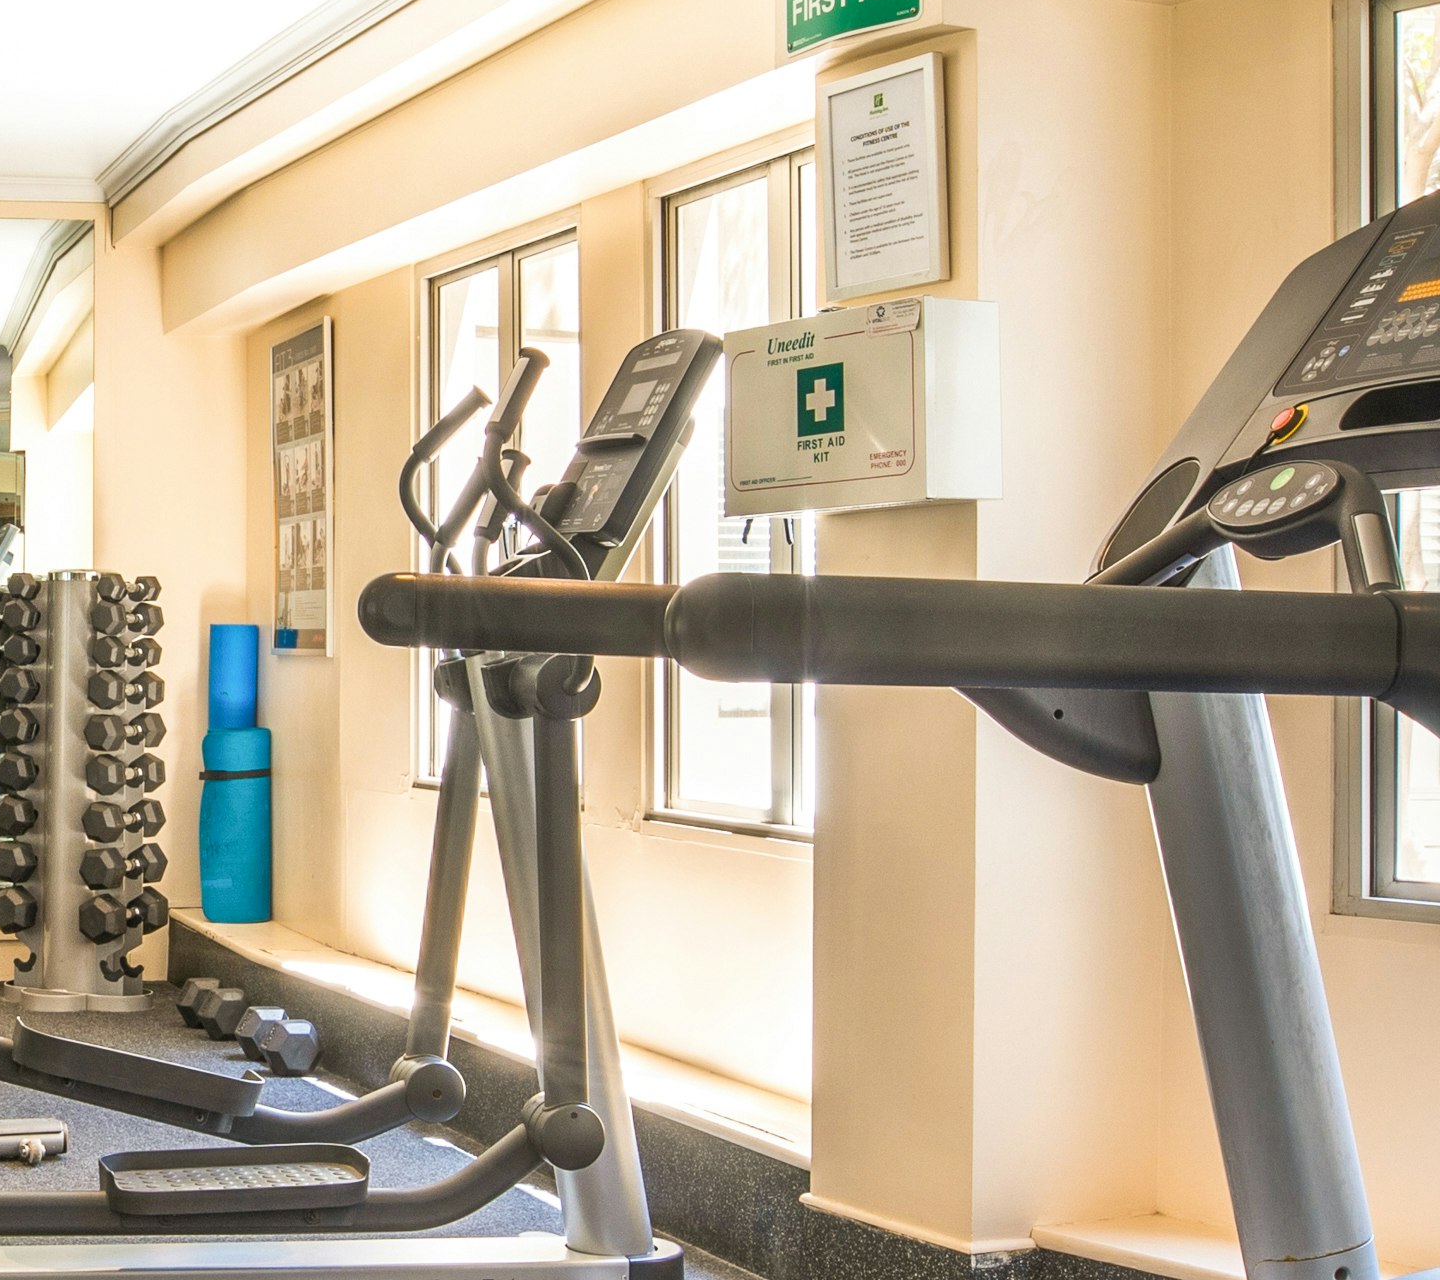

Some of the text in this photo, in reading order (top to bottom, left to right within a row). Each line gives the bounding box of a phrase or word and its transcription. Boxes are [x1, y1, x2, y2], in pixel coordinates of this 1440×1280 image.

[767, 331, 815, 355] Uneedit
[767, 358, 782, 367] FIRST
[789, 354, 804, 363] FIRST
[805, 352, 815, 360] AID
[797, 435, 846, 451] FIRST AID
[813, 451, 830, 463] KIT
[869, 449, 907, 461] EMERGENCY
[896, 459, 907, 467] 000
